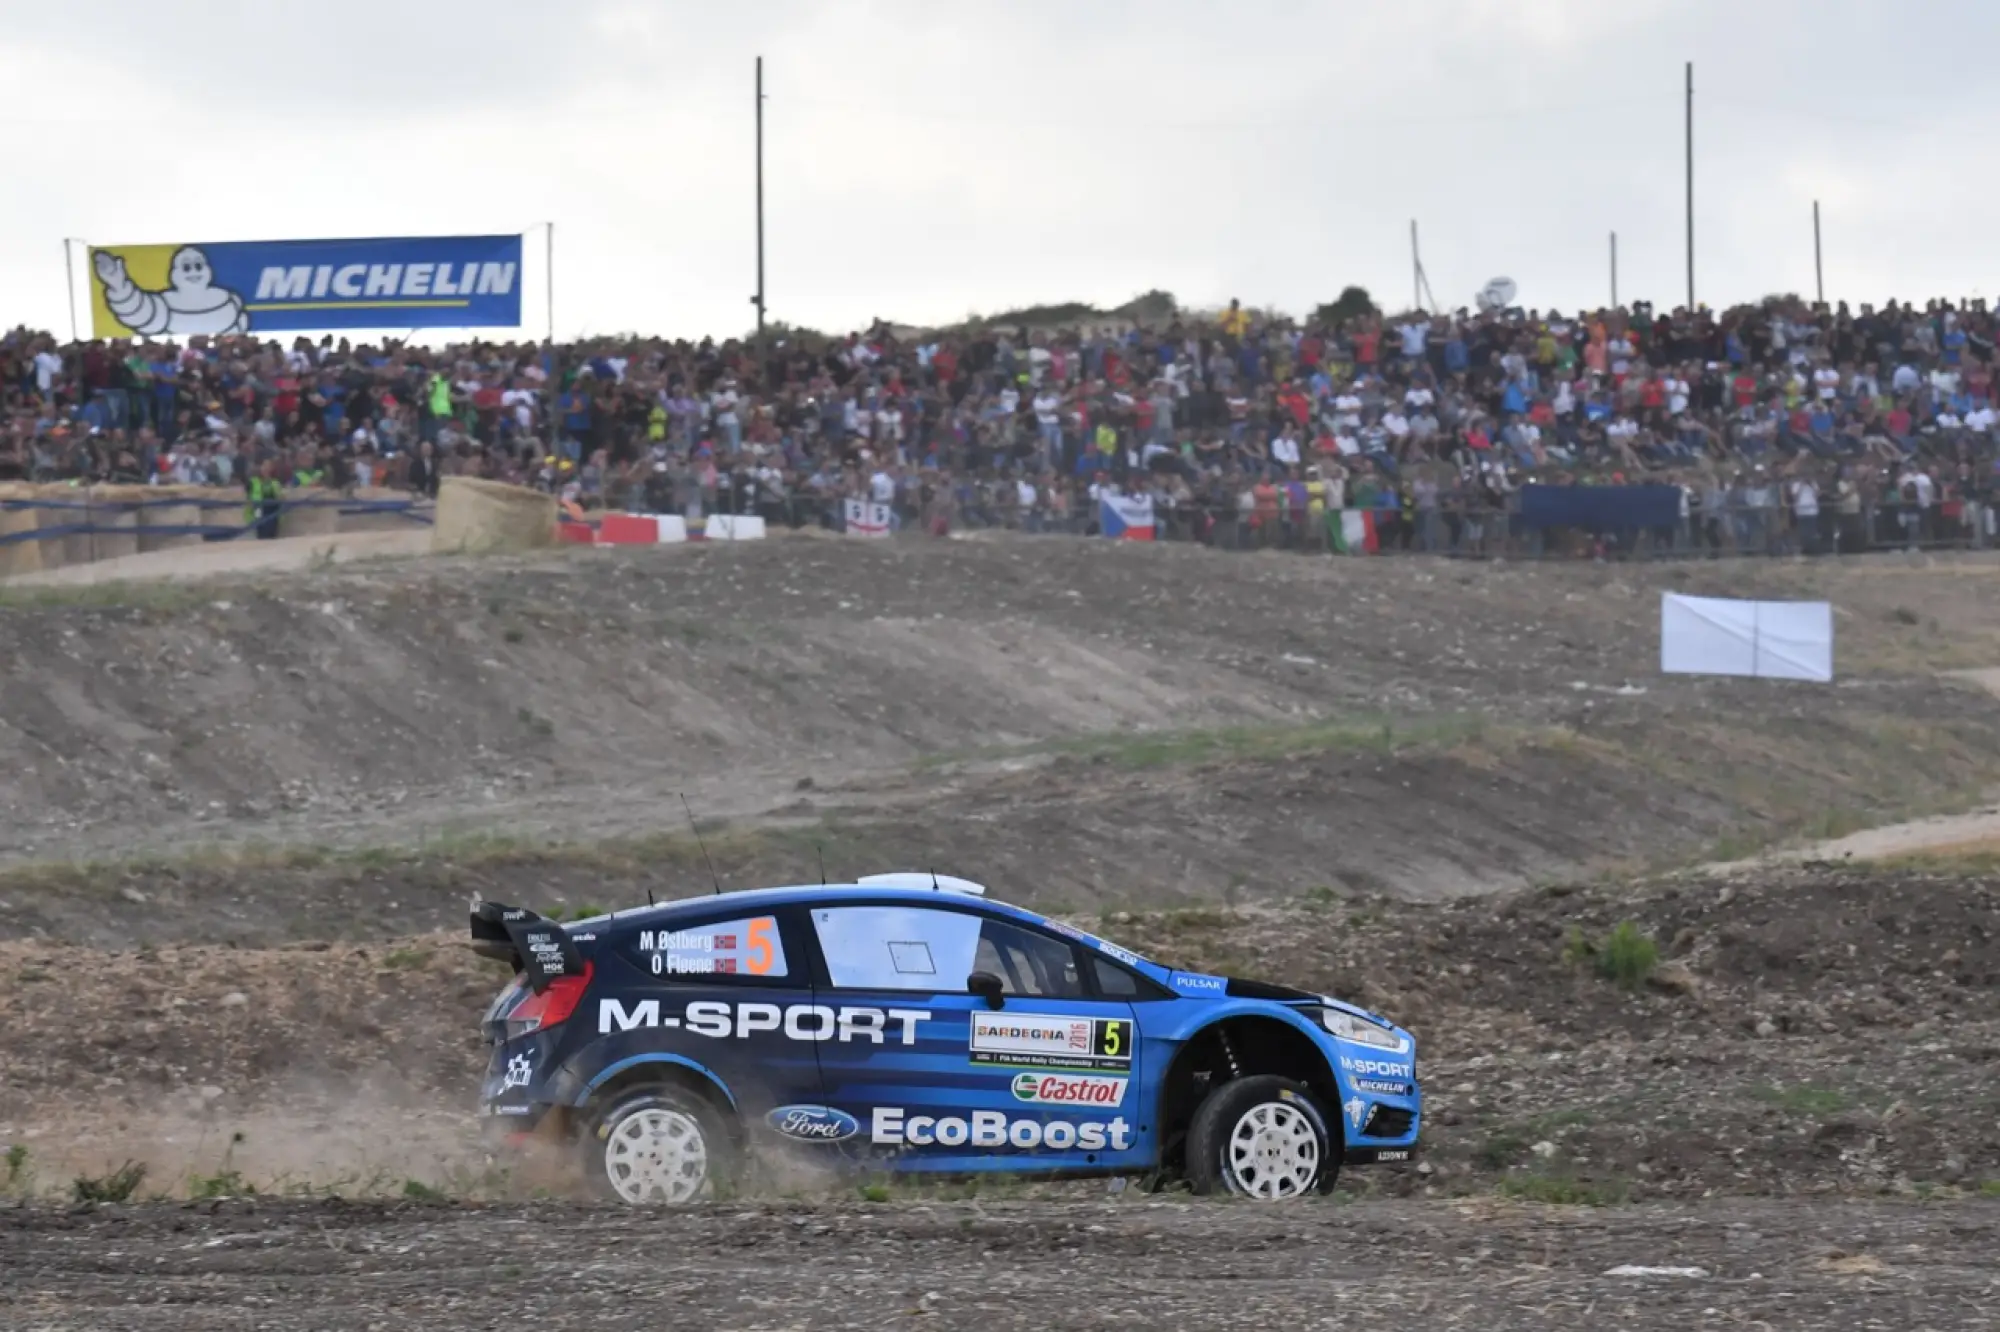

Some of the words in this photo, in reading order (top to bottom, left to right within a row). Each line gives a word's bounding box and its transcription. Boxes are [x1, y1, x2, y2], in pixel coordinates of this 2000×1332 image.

[255, 262, 516, 298] MICHELIN
[640, 931, 654, 950] M
[658, 931, 712, 952] Østberg
[747, 918, 773, 974] 5
[652, 954, 662, 974] O
[1177, 977, 1221, 990] PULSAR
[598, 999, 932, 1045] M-SPORT
[977, 1025, 1065, 1041] SARDEGNA
[1069, 1023, 1088, 1050] 2016
[1104, 1021, 1121, 1056] 5
[1340, 1056, 1409, 1077] M-SPORT
[1039, 1077, 1119, 1103] Castrol
[1360, 1080, 1404, 1093] MICHELIN
[781, 1110, 840, 1139] Ford
[872, 1107, 1130, 1150] EcoBoost
